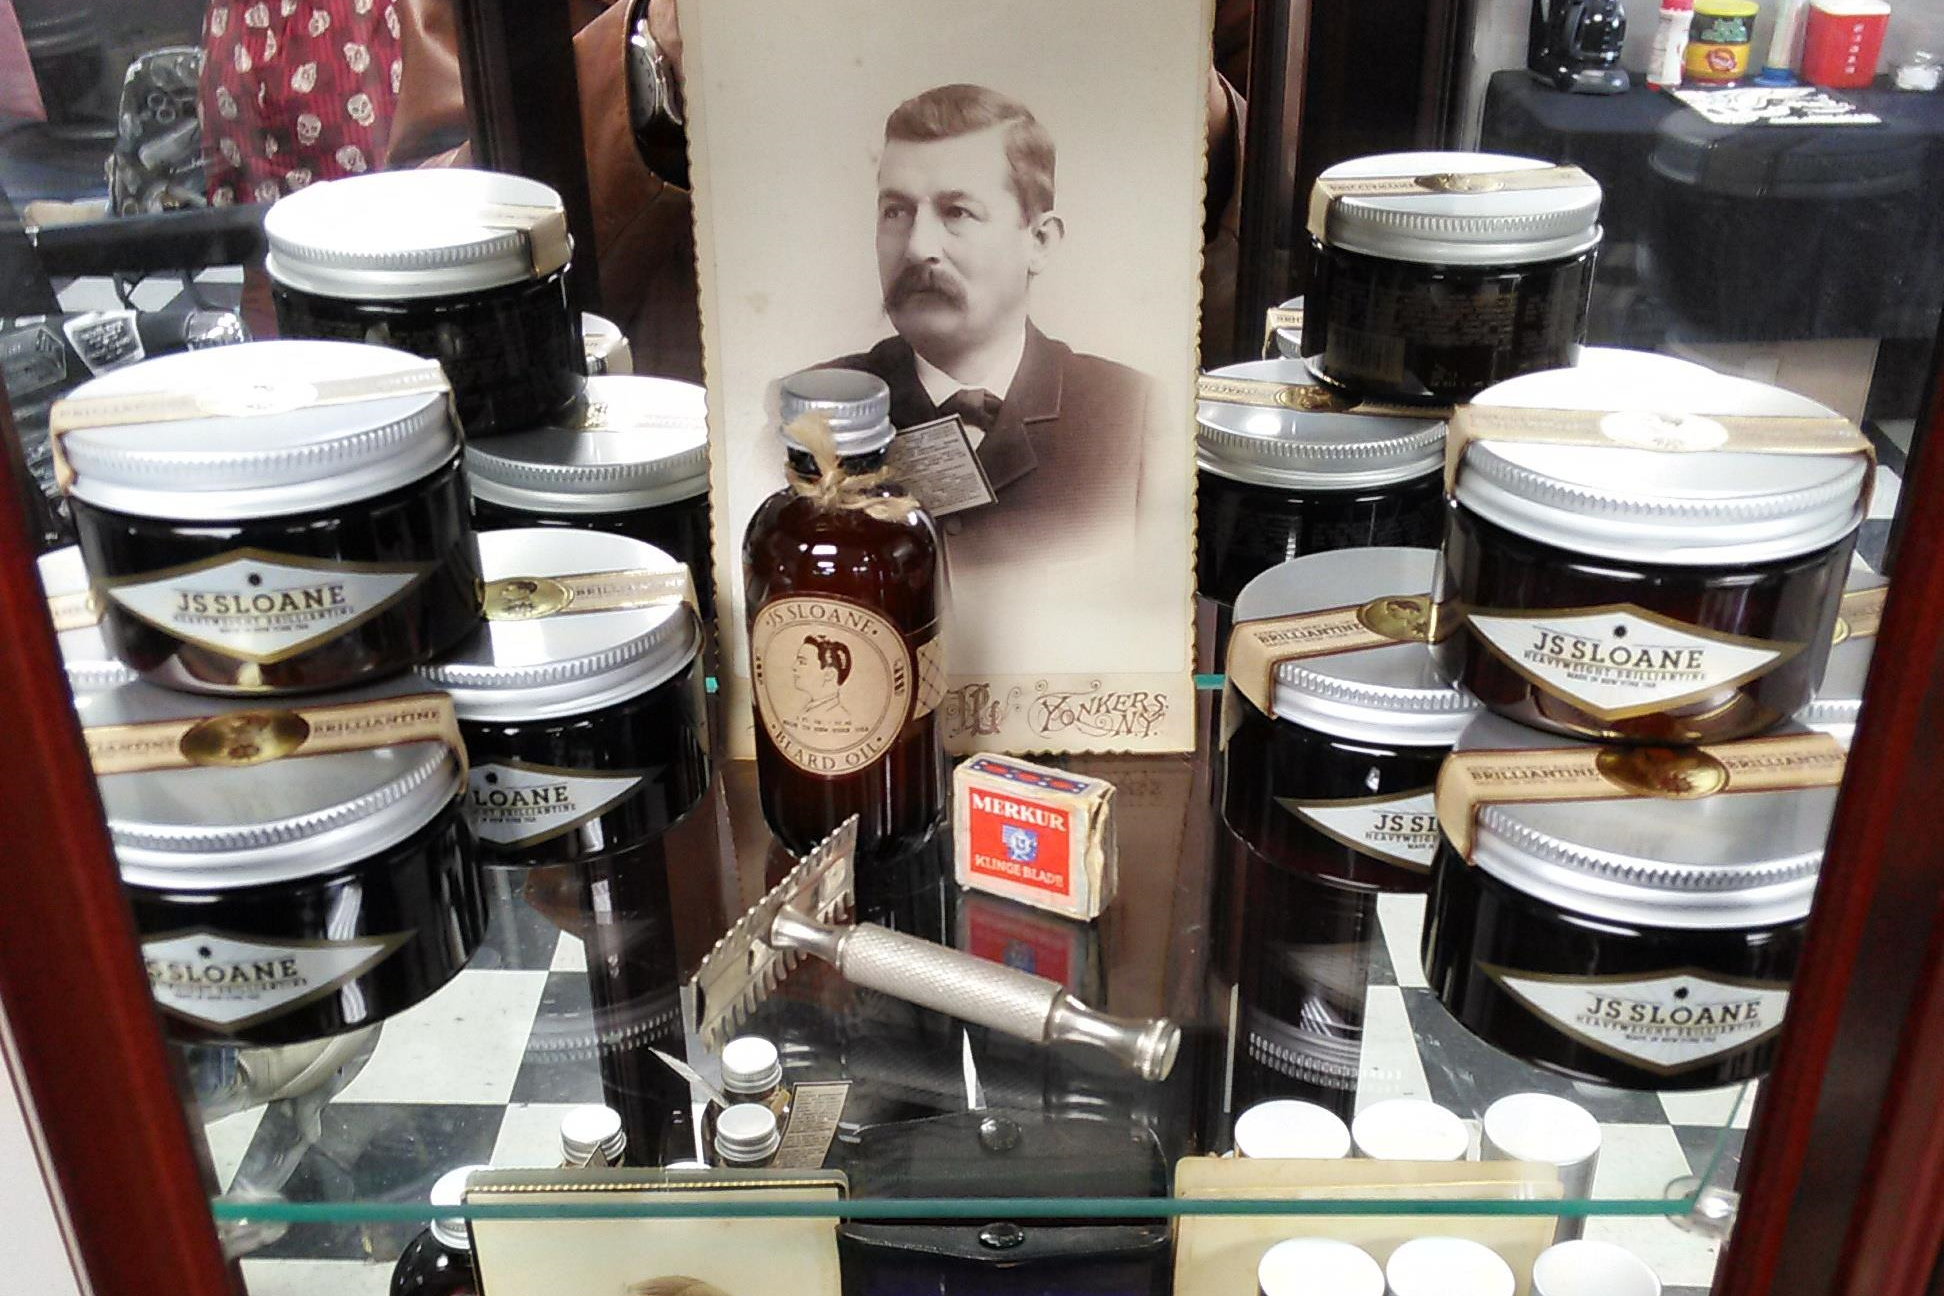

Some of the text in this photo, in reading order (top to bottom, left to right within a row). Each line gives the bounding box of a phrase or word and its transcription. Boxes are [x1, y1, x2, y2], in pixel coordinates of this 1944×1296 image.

[214, 584, 346, 614] SLOANE
[786, 604, 874, 635] SLOANE
[1571, 639, 1705, 670] SLOANE
[775, 731, 881, 770] BEARD OIL
[472, 786, 569, 807] LOANE
[972, 793, 1066, 832] MERKUR
[1023, 866, 1065, 888] BLADE
[1629, 1001, 1761, 1026] SLOANE
